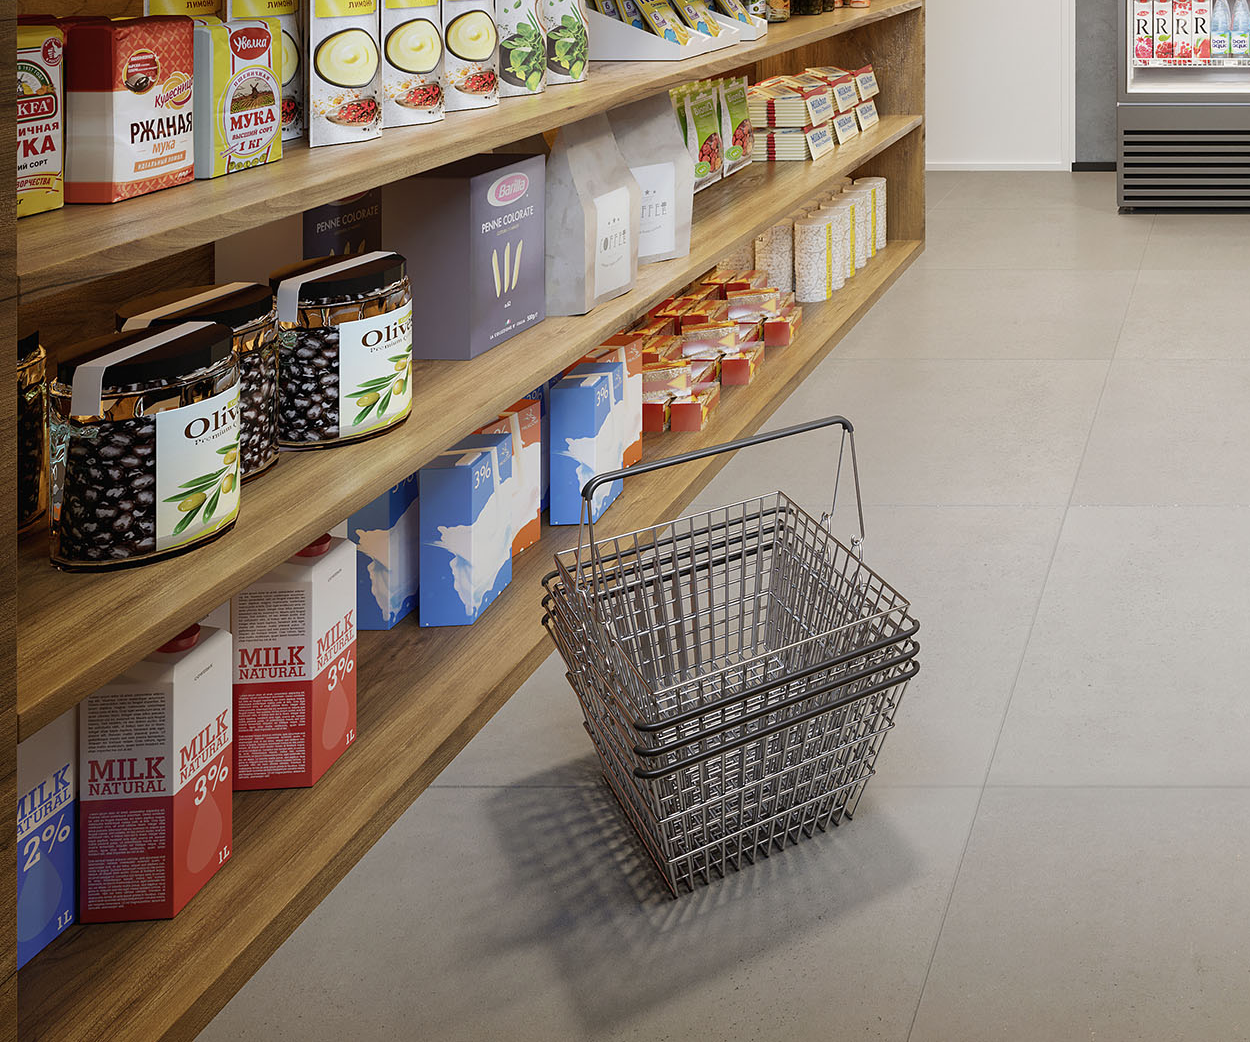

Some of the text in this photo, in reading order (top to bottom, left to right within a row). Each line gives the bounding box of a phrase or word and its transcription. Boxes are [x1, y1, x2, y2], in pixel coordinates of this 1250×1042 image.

[233, 35, 267, 53] Увелка
[17, 100, 50, 115] KFA
[18, 121, 60, 137] ИЧНАЯ
[130, 111, 193, 145] РЖАНАЯ
[230, 108, 276, 132] МУКА
[258, 125, 273, 136] СОРТ
[17, 135, 56, 158] КА
[152, 139, 176, 156] мука
[29, 158, 48, 169] СОРТ
[17, 177, 51, 189] ВОРЧЕСТВА
[498, 178, 527, 199] Barilla
[316, 205, 379, 234] PENNE COLORATE
[481, 217, 502, 234] PENNE
[503, 205, 534, 226] COLORATE
[641, 201, 667, 218] FFEE
[361, 318, 412, 349] Olive
[596, 384, 609, 407] 3%
[184, 401, 240, 440] Oliv
[474, 461, 492, 490] 3%
[316, 608, 354, 660] MILK
[238, 645, 305, 668] MILK
[316, 629, 355, 672] NATURAL
[238, 666, 306, 680] NATURAL
[327, 649, 354, 692] 3%
[179, 708, 229, 772] MILK
[87, 756, 166, 783] MILK
[179, 731, 229, 785] NATURAL
[88, 779, 167, 796] NATURAL
[194, 755, 229, 806] 3%
[17, 787, 72, 837] ATURAL
[23, 813, 71, 873] 2%
[57, 909, 73, 931] 1L
